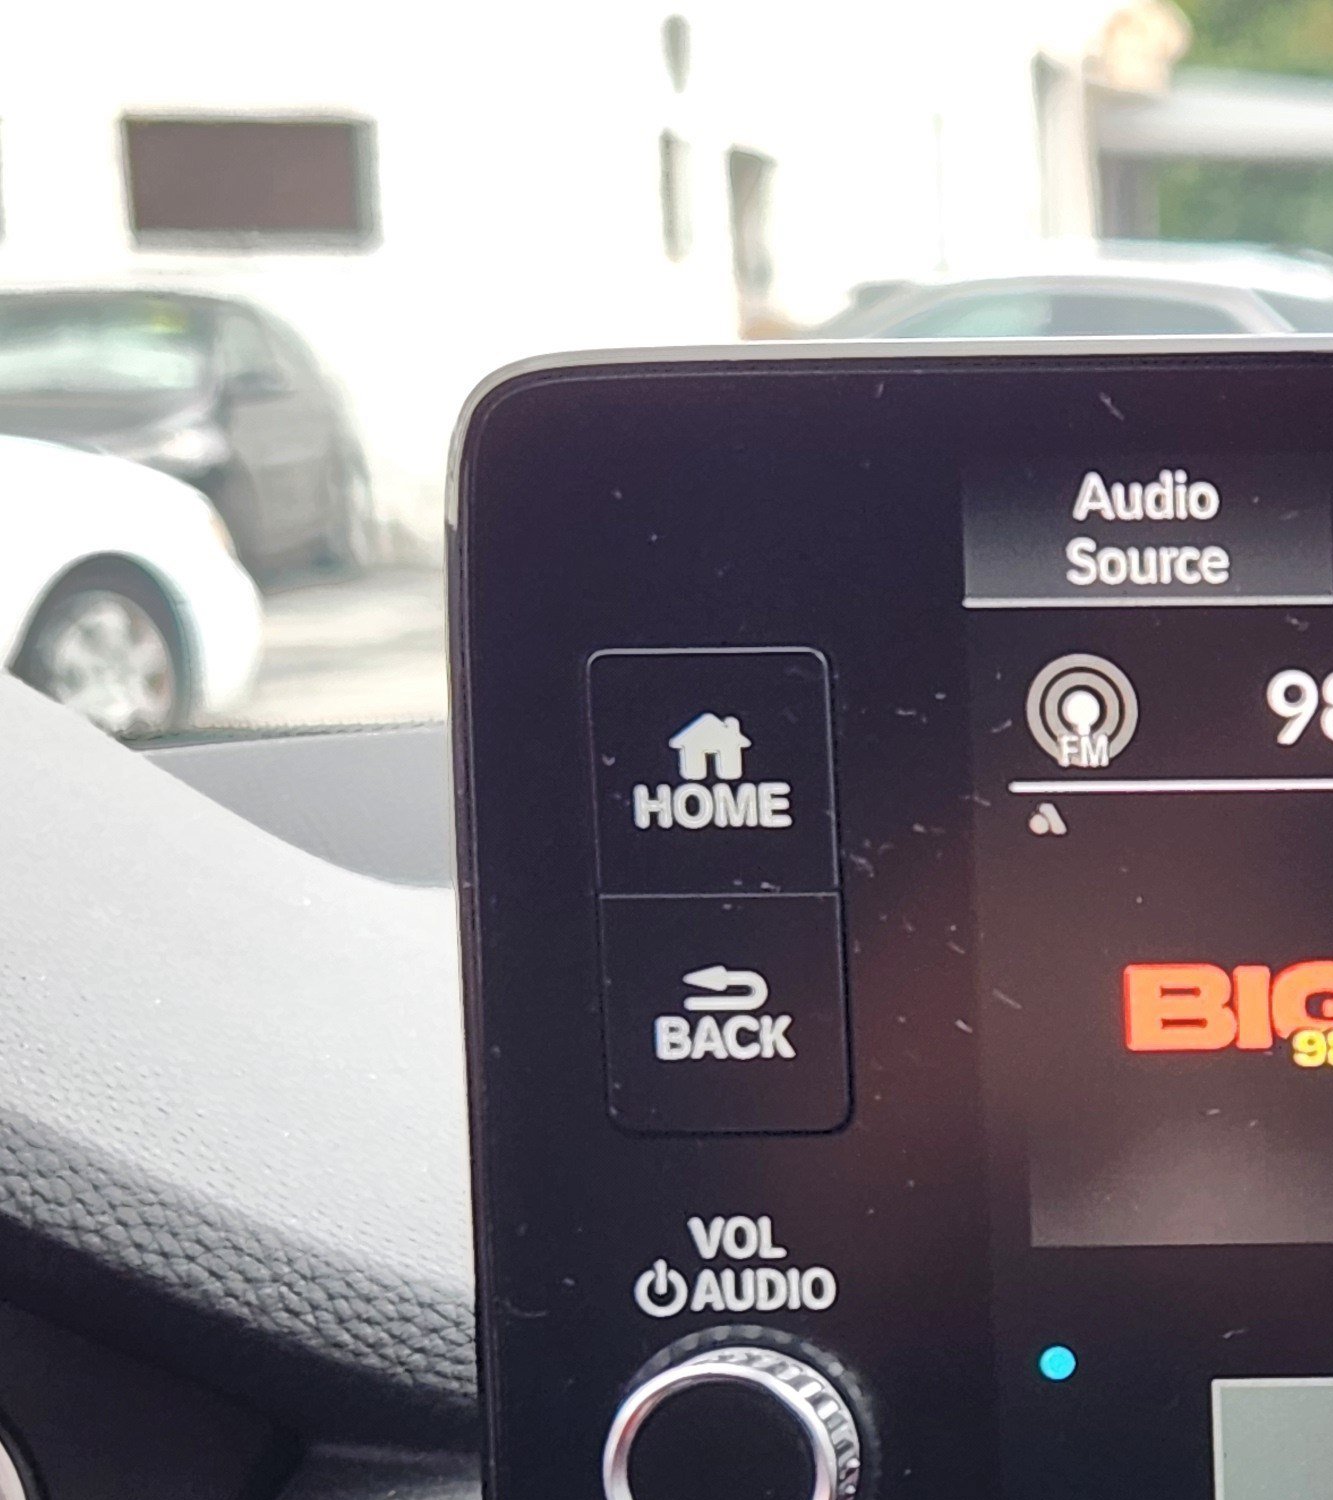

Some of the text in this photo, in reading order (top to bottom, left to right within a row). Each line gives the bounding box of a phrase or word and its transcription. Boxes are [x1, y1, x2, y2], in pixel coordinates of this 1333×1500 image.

[1071, 469, 1221, 522] Audio
[1065, 536, 1231, 587] Source
[1058, 733, 1111, 768] FM
[632, 782, 793, 830] HOME
[654, 1014, 796, 1060] BACK
[687, 1216, 788, 1260] VOL
[690, 1266, 838, 1312] AUDIO
